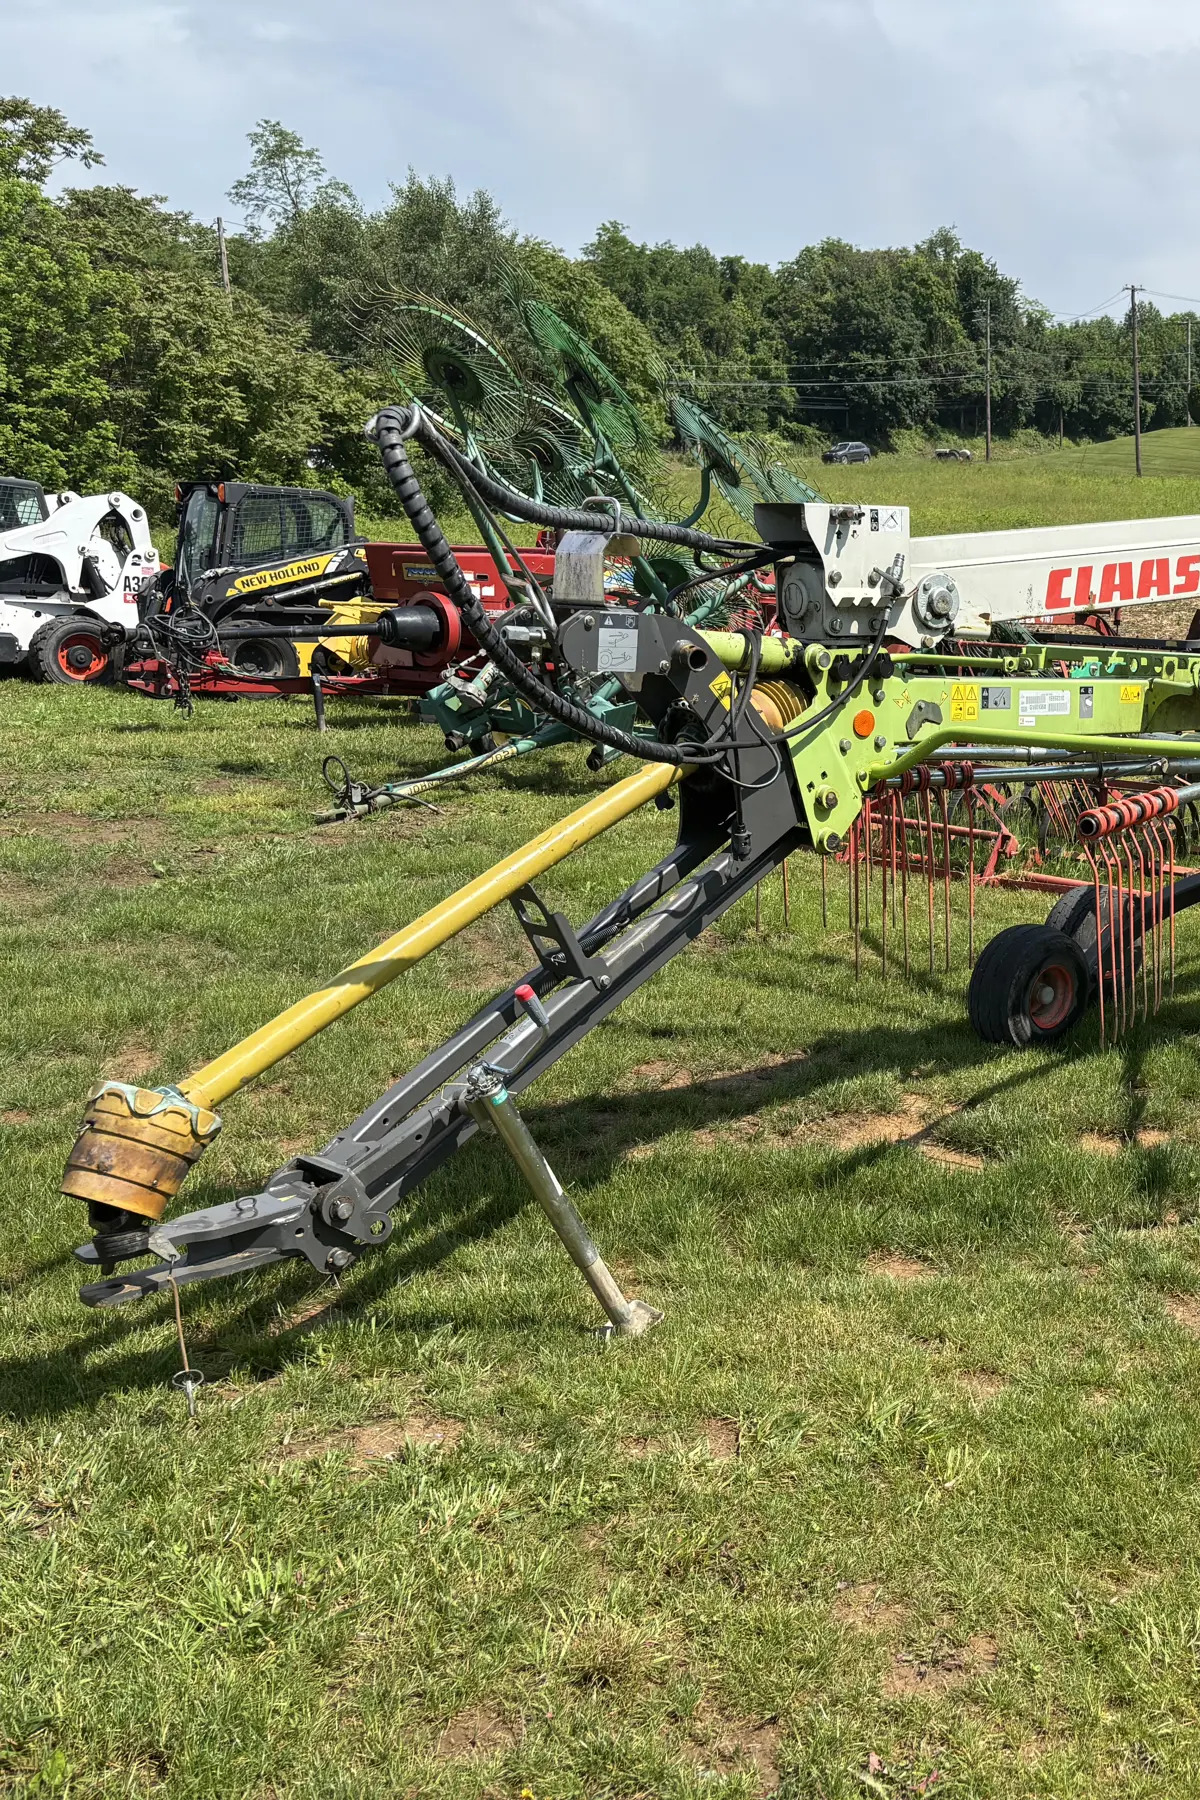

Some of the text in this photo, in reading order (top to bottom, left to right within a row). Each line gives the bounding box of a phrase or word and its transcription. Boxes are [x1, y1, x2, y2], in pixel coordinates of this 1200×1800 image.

[241, 572, 267, 589] NEW
[270, 562, 320, 582] HOLLAND
[408, 781, 435, 796] JOHN
